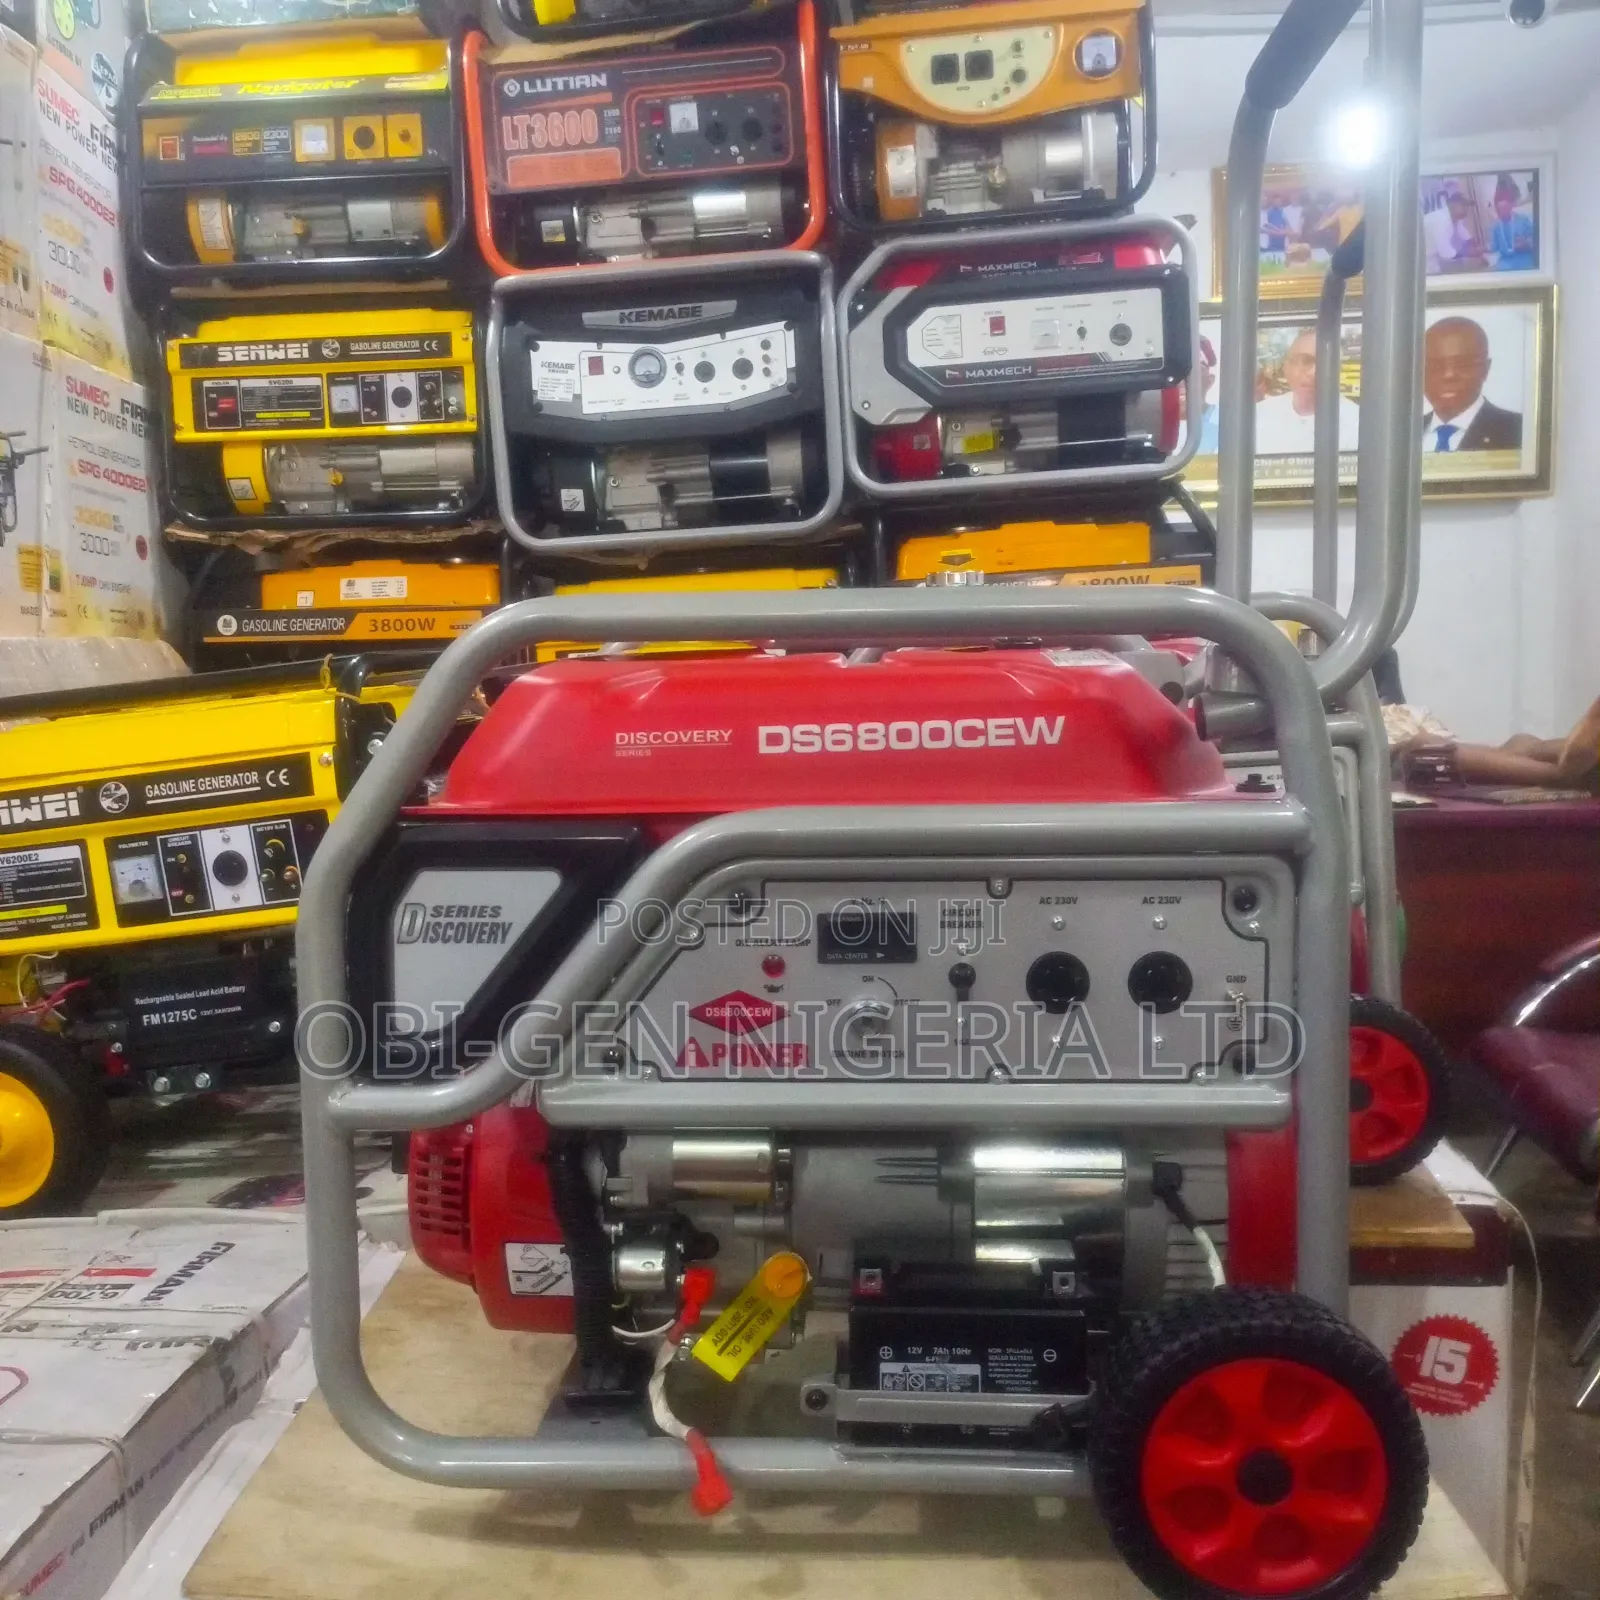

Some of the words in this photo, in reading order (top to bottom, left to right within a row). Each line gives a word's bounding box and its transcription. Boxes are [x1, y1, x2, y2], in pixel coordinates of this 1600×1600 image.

[523, 73, 608, 94] LUTIAN
[37, 78, 80, 126] SUMEC
[39, 98, 60, 128] NEW
[65, 119, 98, 158] POWER
[502, 108, 599, 151] LT3600
[978, 261, 1037, 272] MAXMECH
[619, 305, 703, 325] KEMAGE
[217, 342, 310, 362] SENWEI
[350, 341, 381, 351] GASOLINE
[382, 340, 420, 350] GENERATOR
[541, 361, 576, 370] KEMAGE
[965, 366, 1032, 379] MAXMECH
[66, 375, 110, 409] SUMEC
[67, 396, 89, 416] NEW
[93, 406, 128, 432] POWER
[80, 532, 109, 556] 3000
[242, 619, 288, 632] GASOLINE
[289, 617, 346, 631] GENERATOR
[368, 618, 436, 633] 3800W
[615, 729, 733, 745] DISCOVERY
[757, 715, 1066, 753] DS6800CEW
[615, 749, 652, 757] SERIES
[146, 778, 197, 799] GASOLINE
[198, 771, 259, 791] GENERATOR
[118, 840, 149, 850] VOLTMETER
[1039, 897, 1053, 905] AC
[1055, 896, 1078, 905] 230V
[1142, 897, 1156, 905] AC
[1157, 896, 1181, 905] 230V
[430, 904, 503, 919] SERIES
[862, 975, 874, 983] ON
[1226, 974, 1247, 984] GND
[135, 994, 175, 1006] Rechargeable
[175, 991, 195, 1001] Sealed
[195, 989, 210, 999] Lead
[210, 987, 224, 996] Acid
[224, 985, 246, 994] Battery
[142, 1008, 197, 1026] FM1275C
[705, 1007, 772, 1017] DS6800CEW
[140, 1241, 236, 1302] FIRMAN
[727, 1345, 742, 1358] OIL
[932, 1347, 949, 1355] 7Ah
[951, 1347, 972, 1356] 10Hr
[1420, 1335, 1472, 1384] 15
